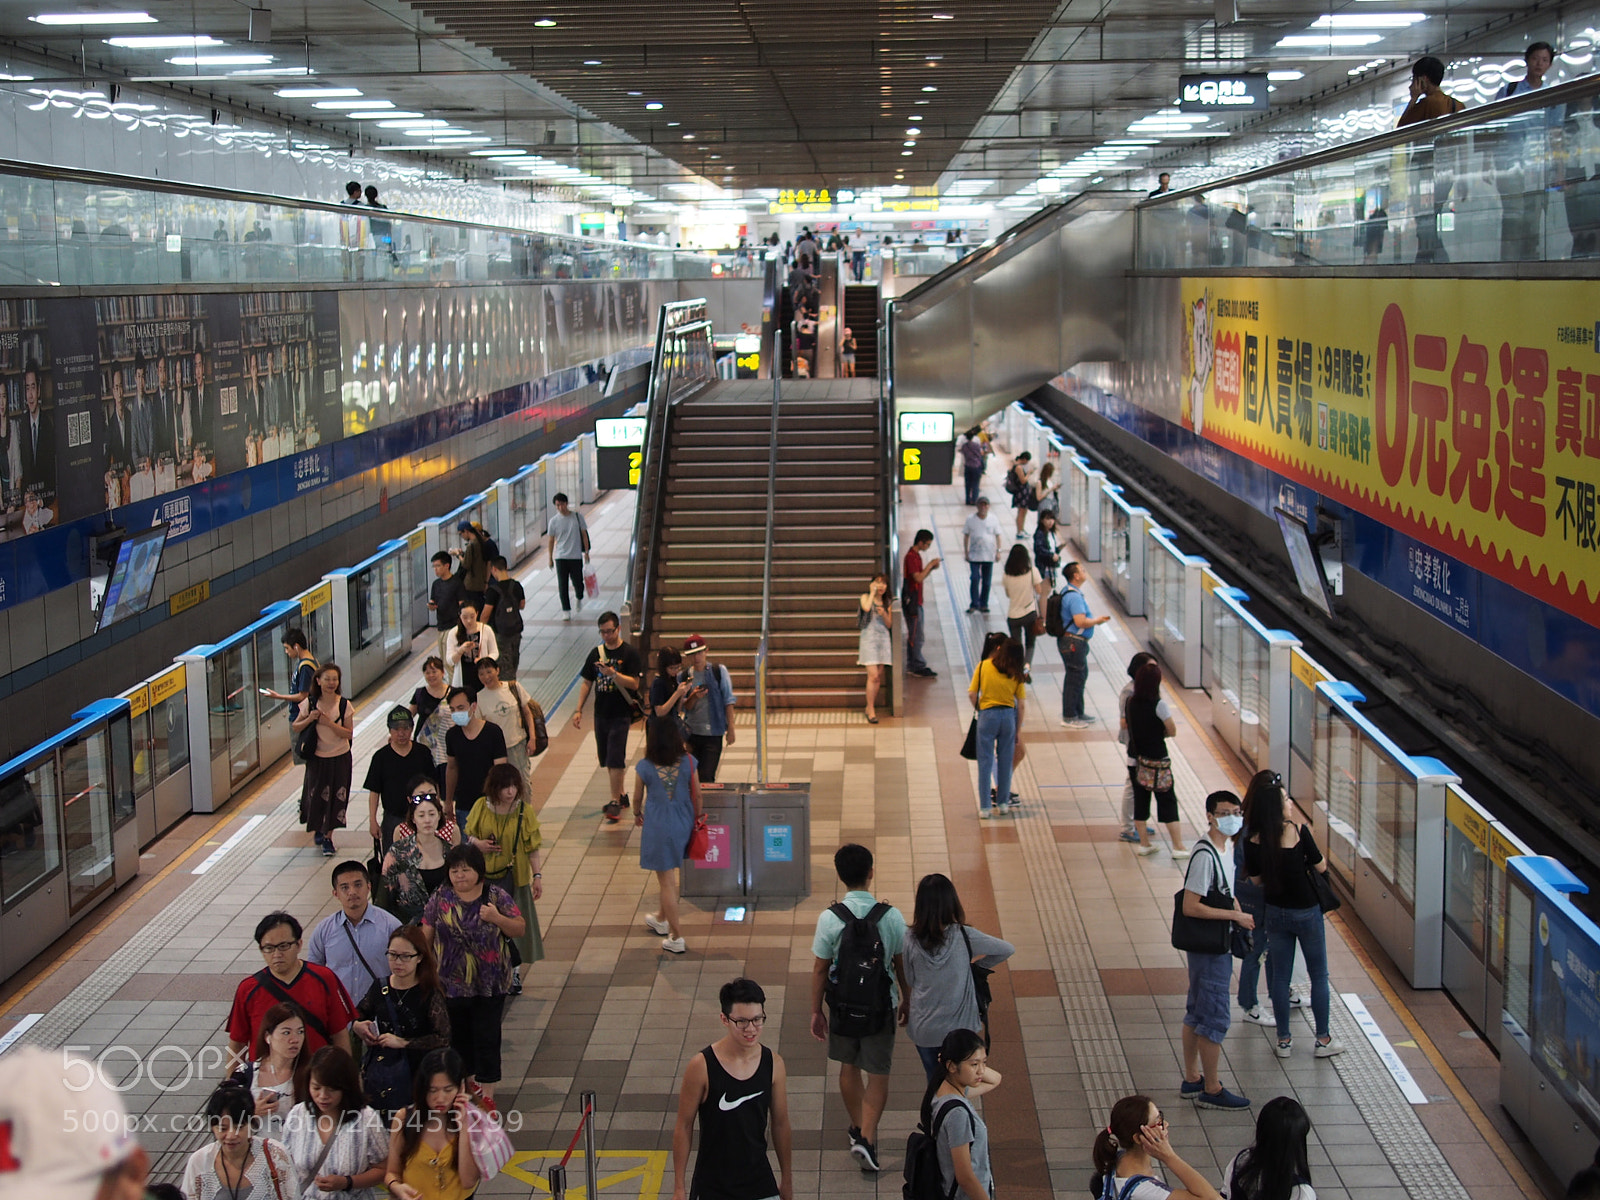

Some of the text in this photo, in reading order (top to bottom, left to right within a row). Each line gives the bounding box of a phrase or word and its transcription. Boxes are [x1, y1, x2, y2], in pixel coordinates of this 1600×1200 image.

[1243, 331, 1313, 446] 個人賣場
[1324, 345, 1365, 397] 9月限定
[1329, 408, 1371, 465] 寄件取件
[1376, 302, 1549, 537] 0元免運
[1555, 475, 1600, 553] 不限
[1415, 548, 1451, 595] 忠孝敦化
